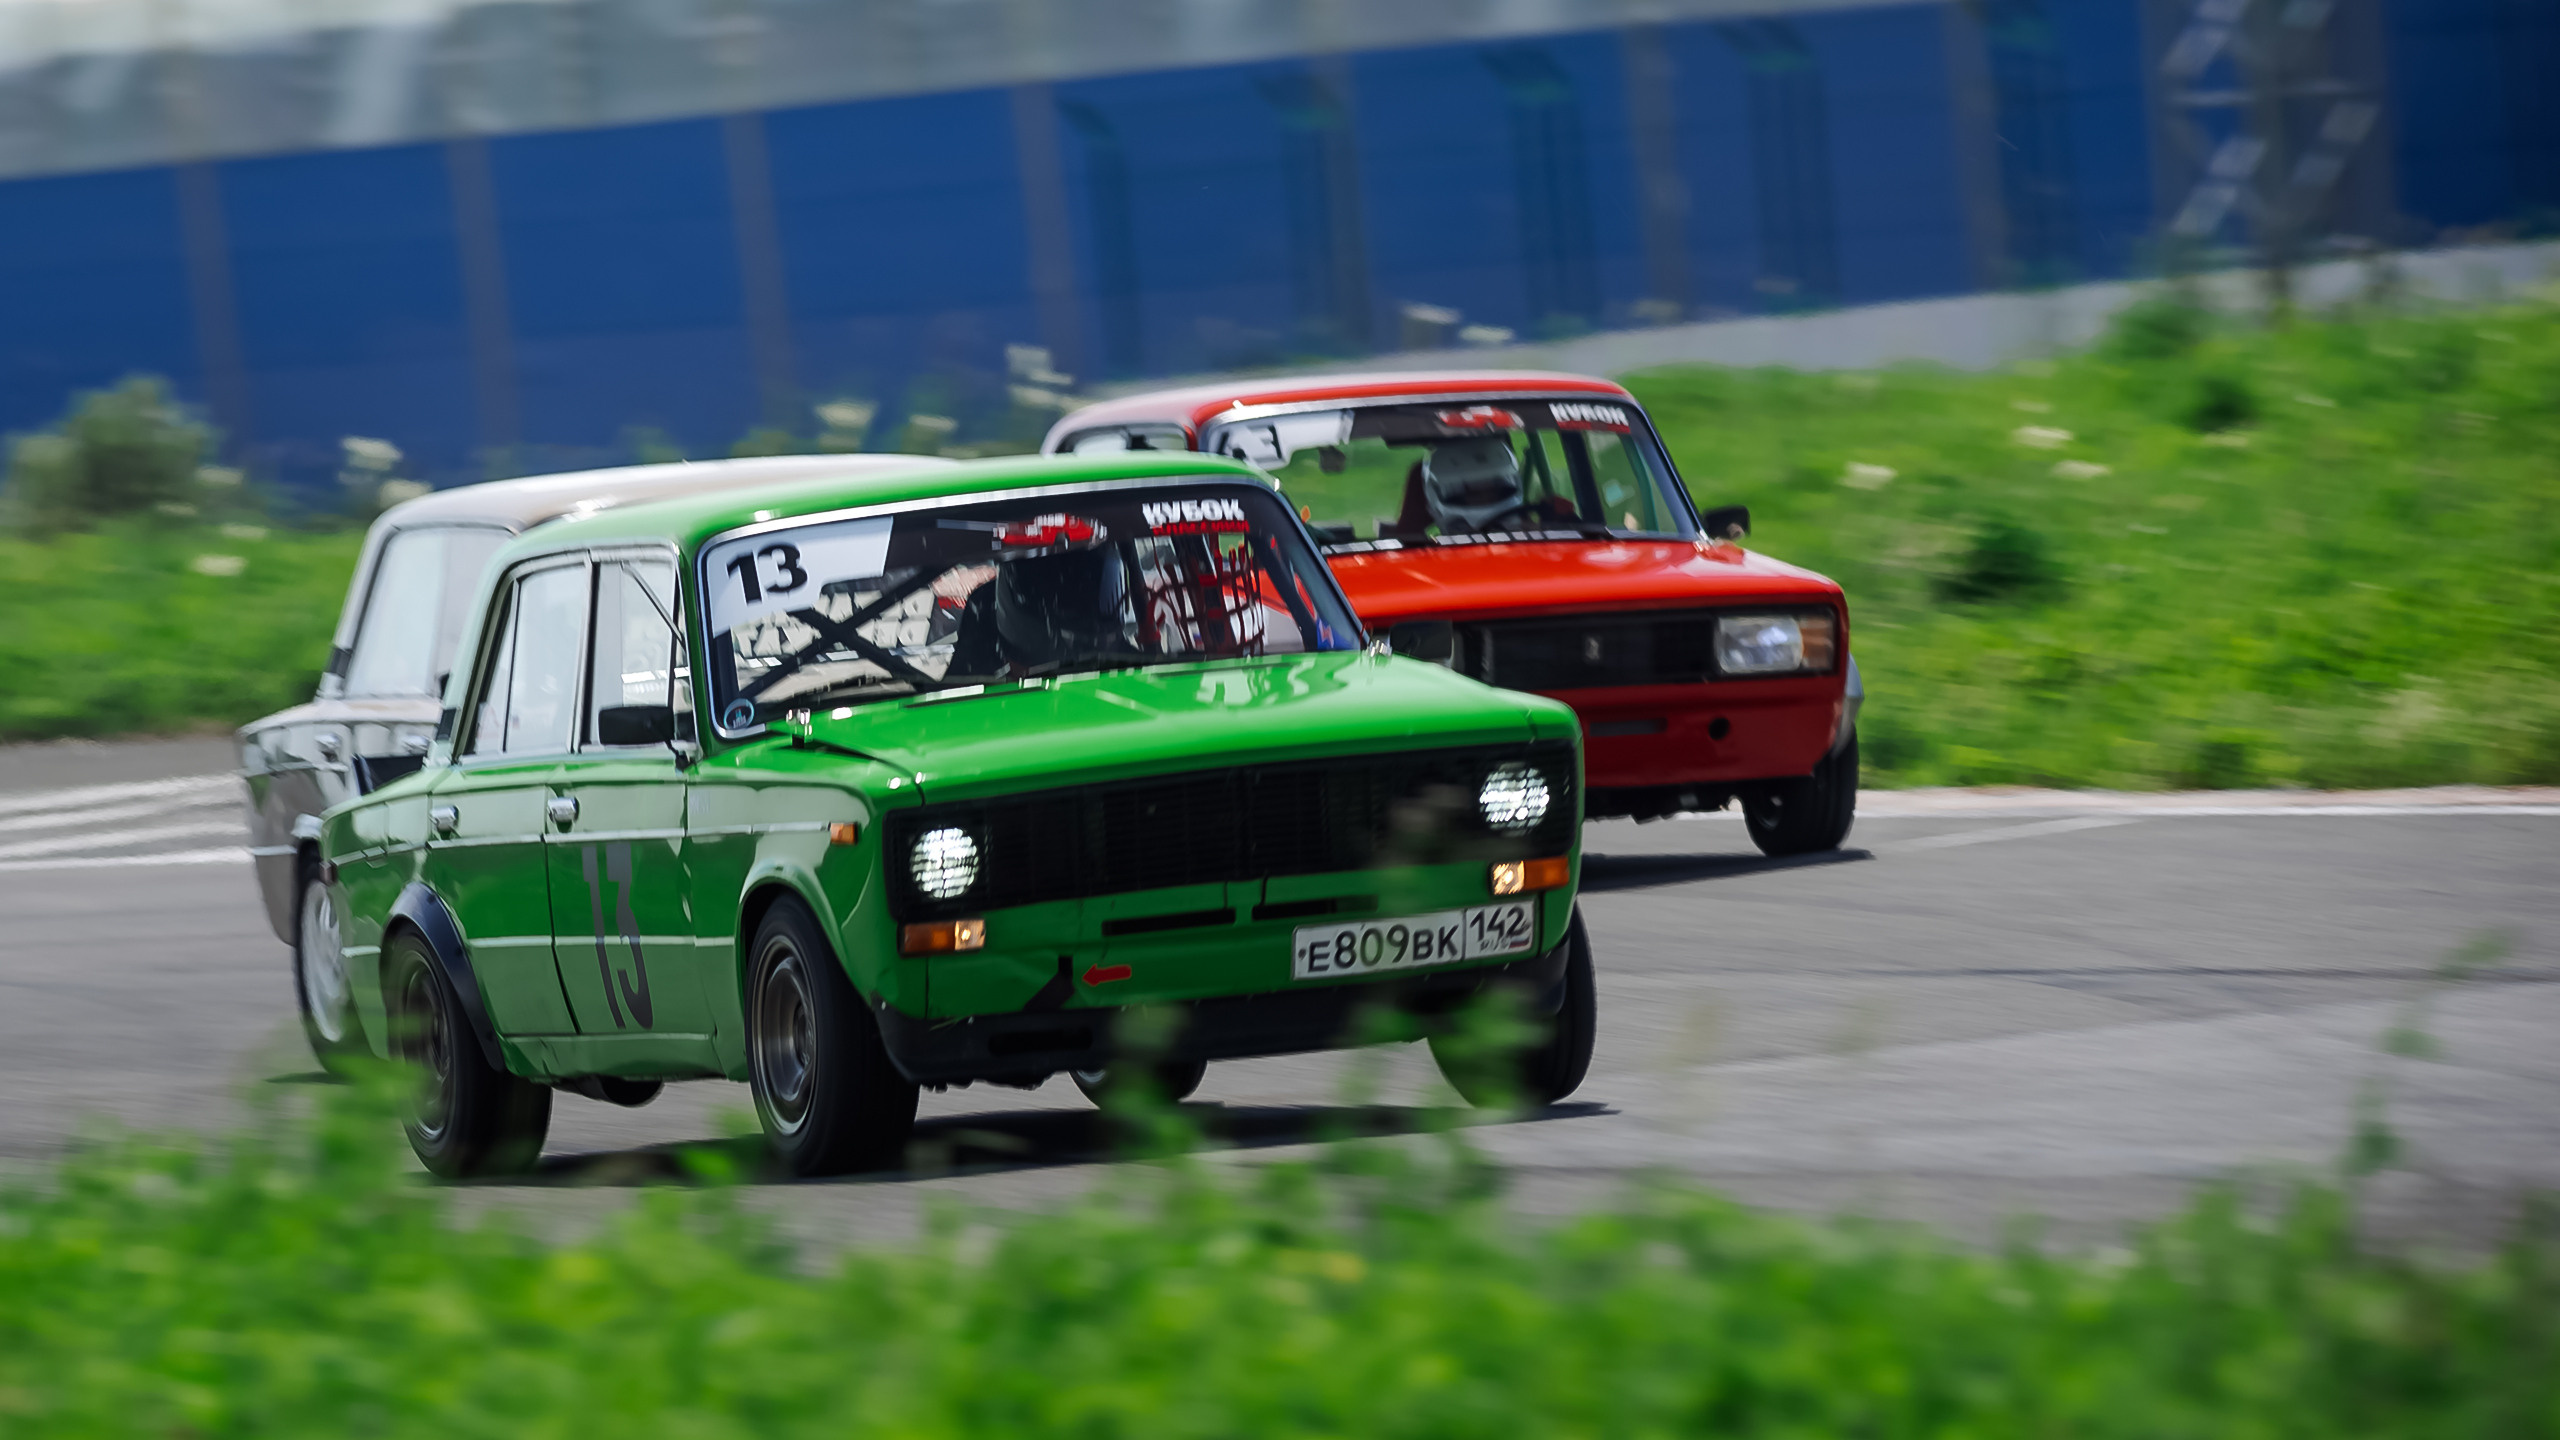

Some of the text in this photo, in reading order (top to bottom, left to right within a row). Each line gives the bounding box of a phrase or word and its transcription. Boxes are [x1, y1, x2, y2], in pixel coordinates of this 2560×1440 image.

[1142, 499, 1245, 528] КУБОК
[726, 544, 808, 604] 13
[582, 842, 654, 1030] 13
[1308, 905, 1530, 973] Е809ВК 142
